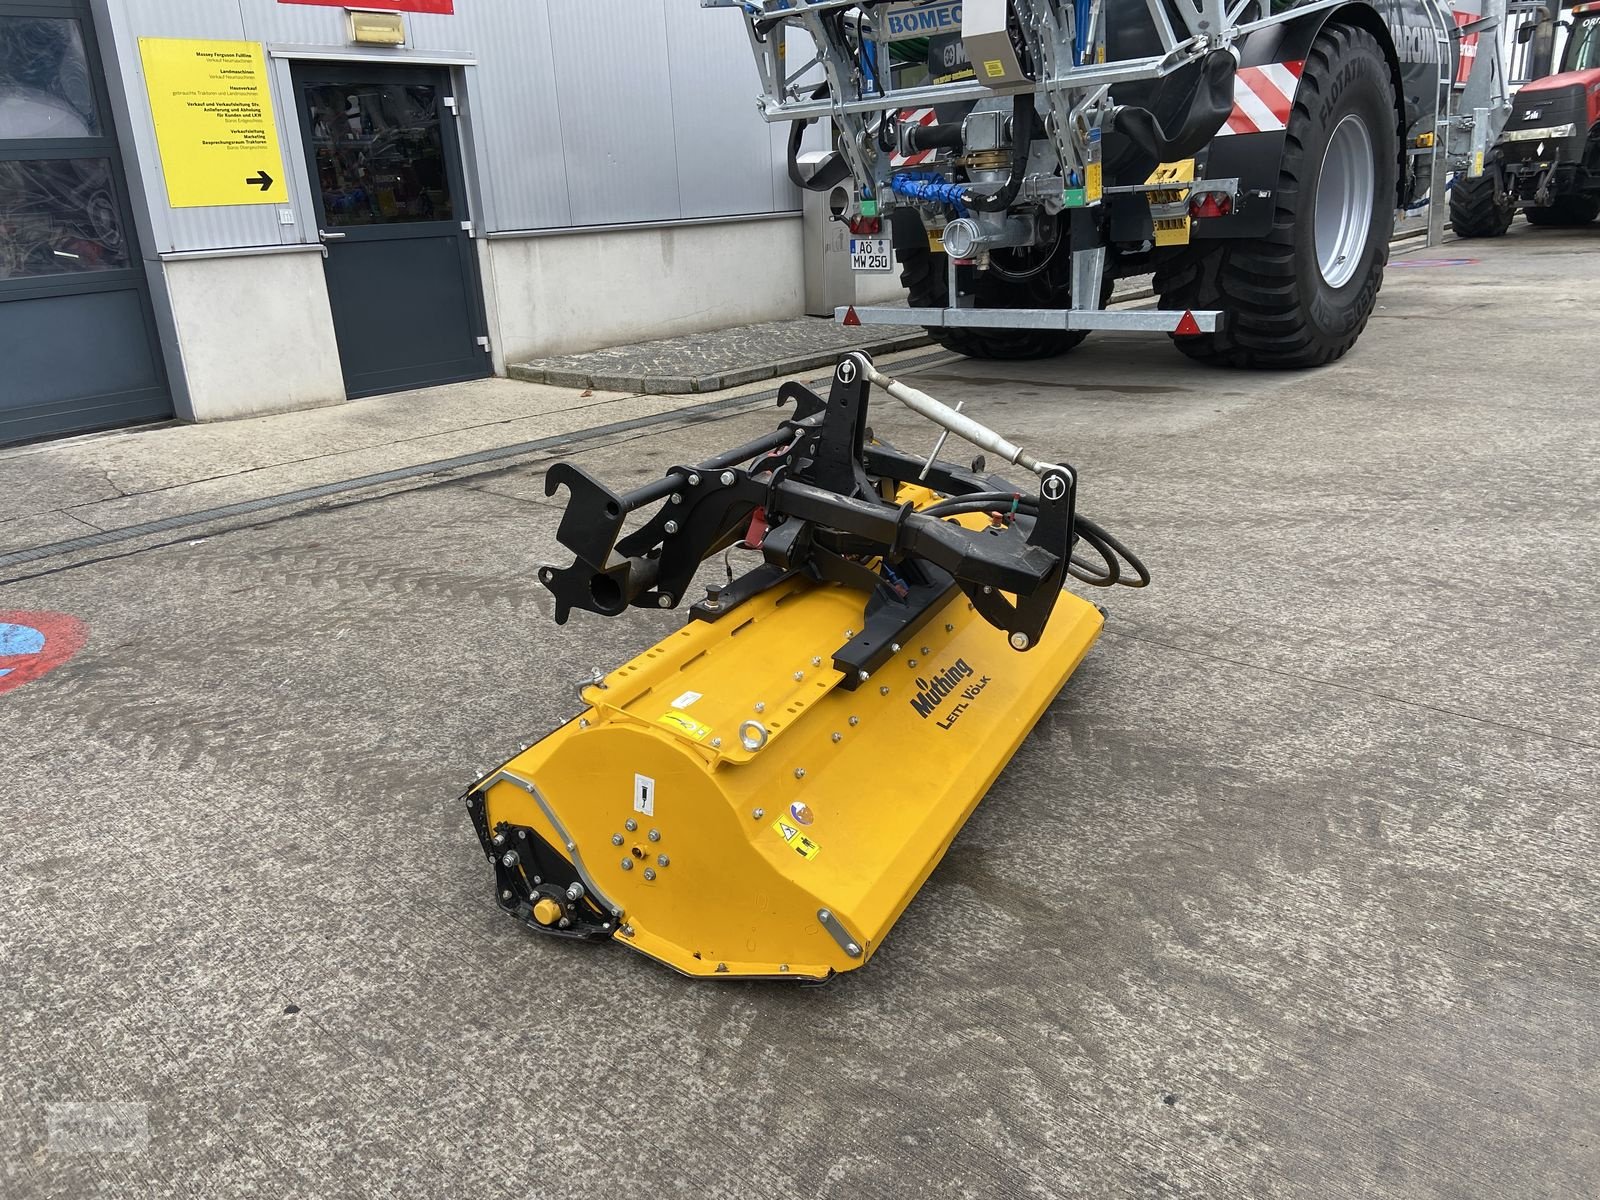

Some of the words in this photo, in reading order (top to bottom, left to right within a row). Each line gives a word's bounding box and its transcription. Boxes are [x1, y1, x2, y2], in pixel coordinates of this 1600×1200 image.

[888, 5, 962, 34] BOMEC
[860, 241, 873, 254] AÖ
[853, 255, 867, 268] MW
[868, 255, 888, 268] 250
